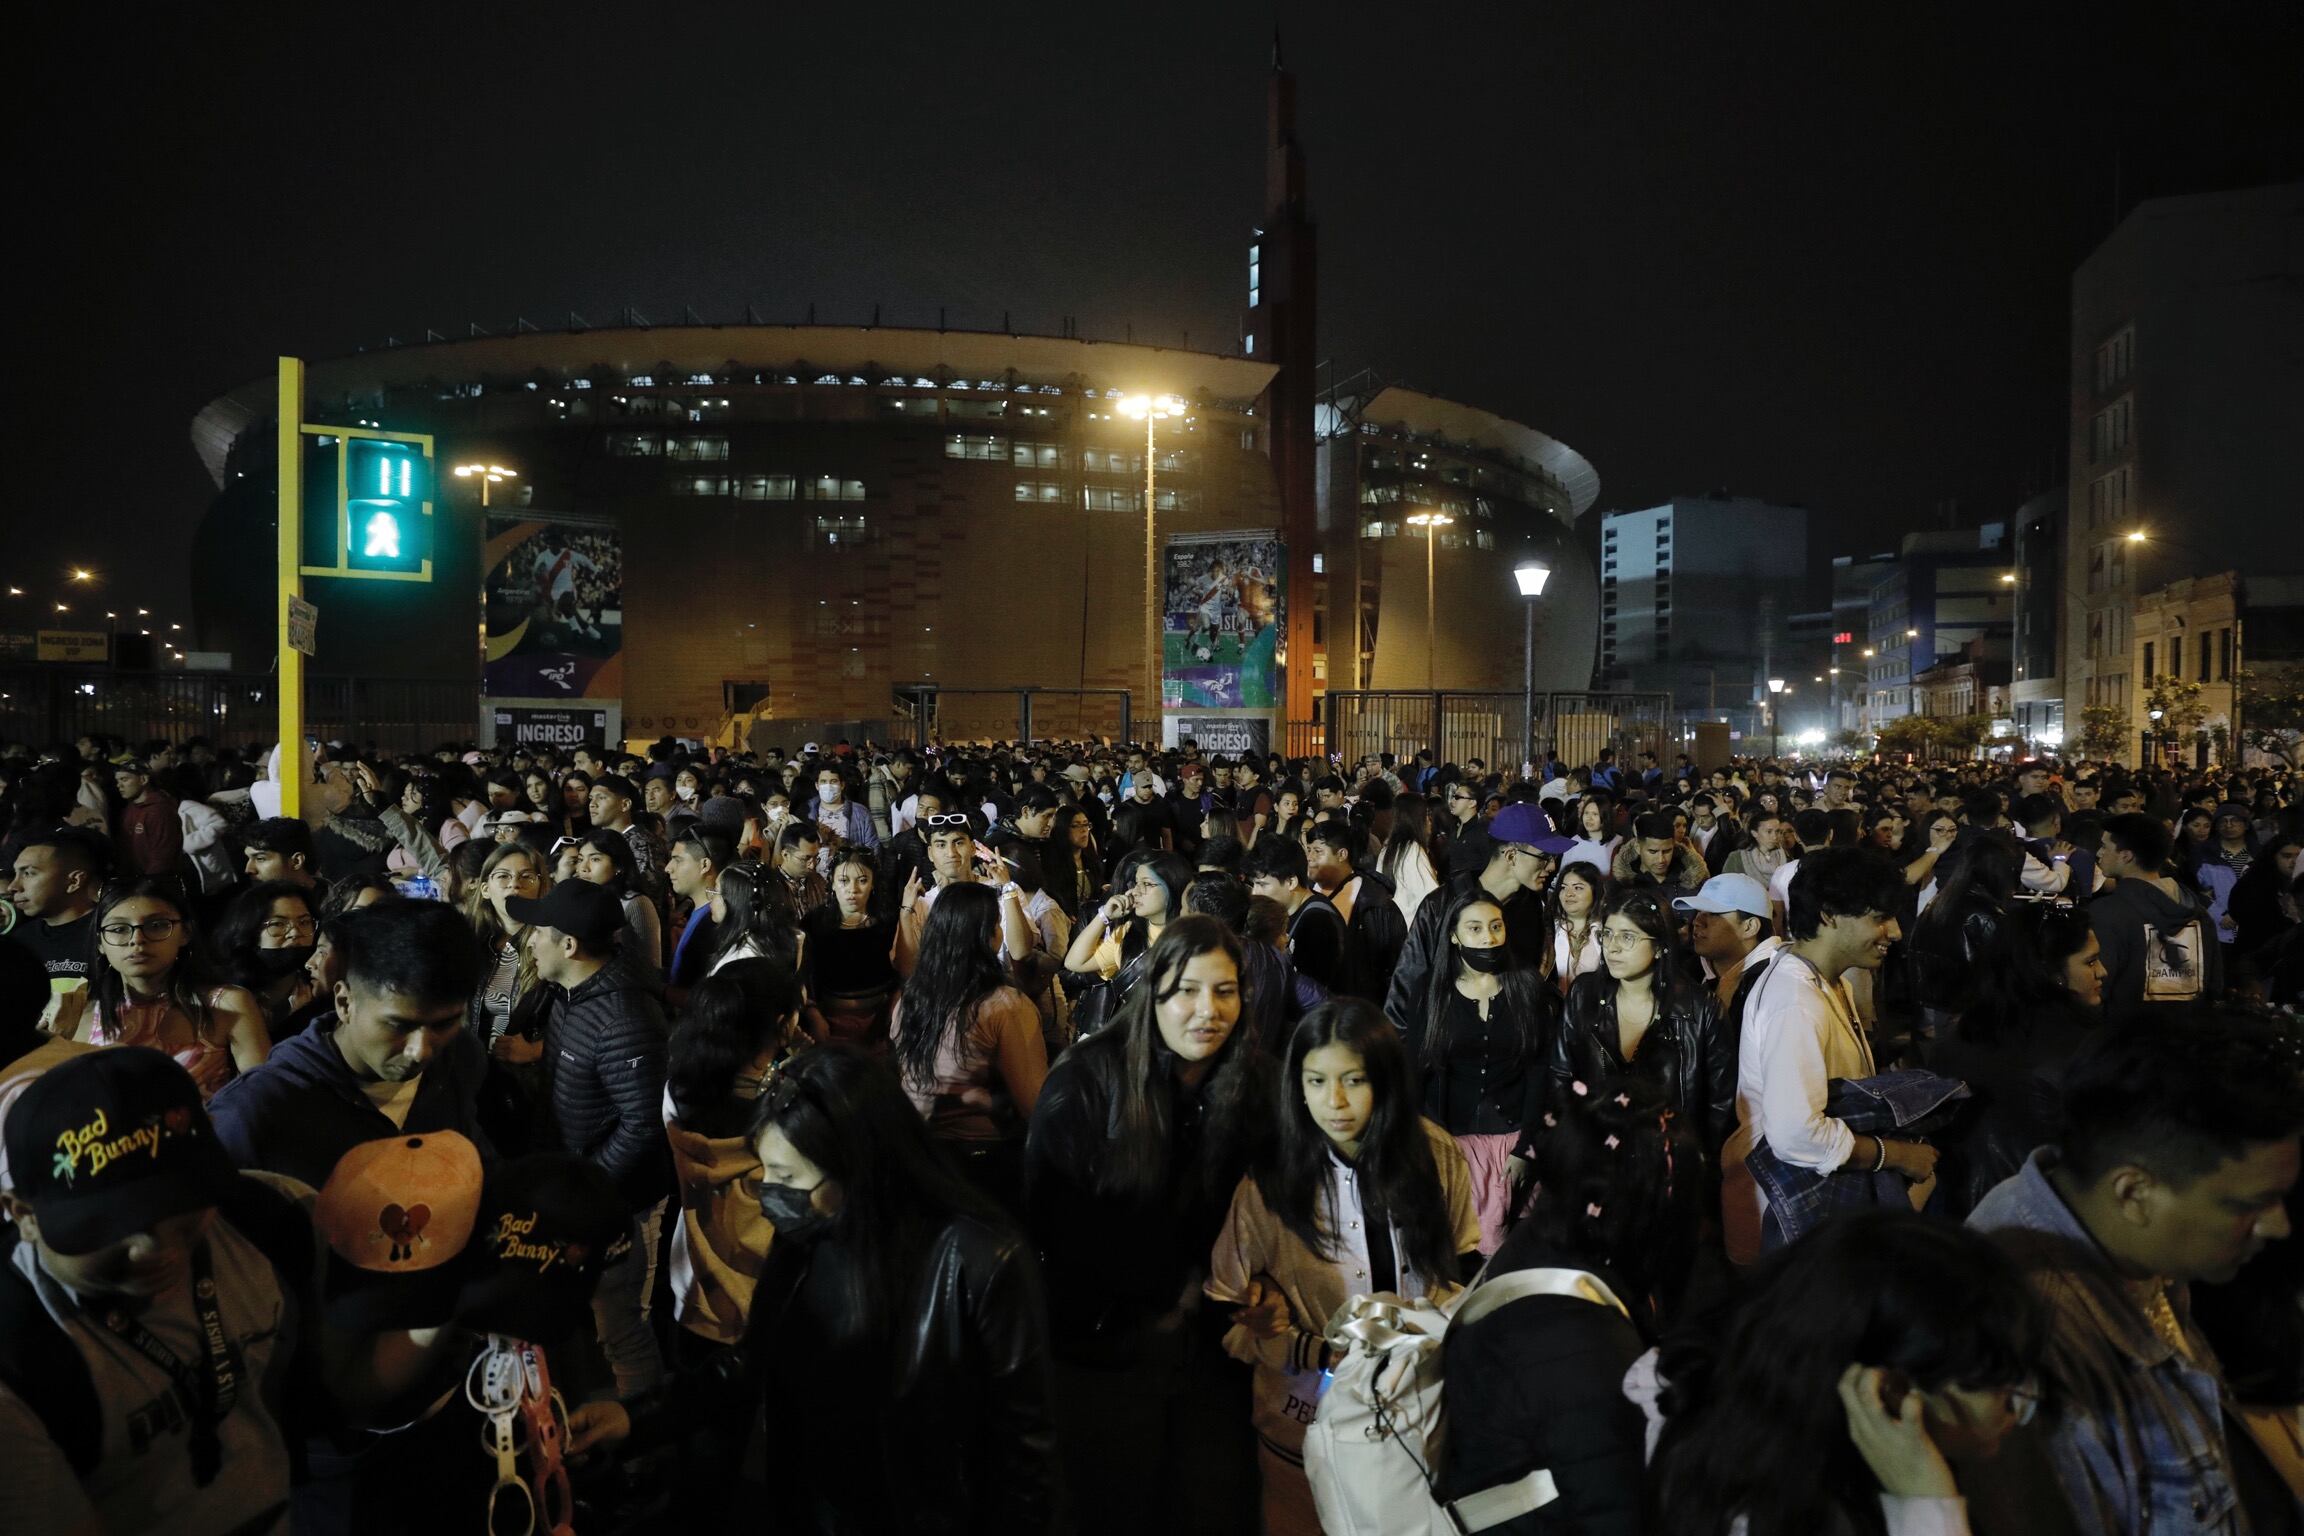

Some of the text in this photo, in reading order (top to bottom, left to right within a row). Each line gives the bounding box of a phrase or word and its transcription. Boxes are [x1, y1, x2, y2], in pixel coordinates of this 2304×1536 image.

[380, 457, 411, 497] 11
[516, 723, 585, 742] INGRESO
[1195, 733, 1251, 750] INGRESO
[56, 1107, 109, 1168] Bad
[84, 1123, 160, 1177] Bunny
[498, 1210, 539, 1242] Bad
[500, 1234, 560, 1274] Bunny
